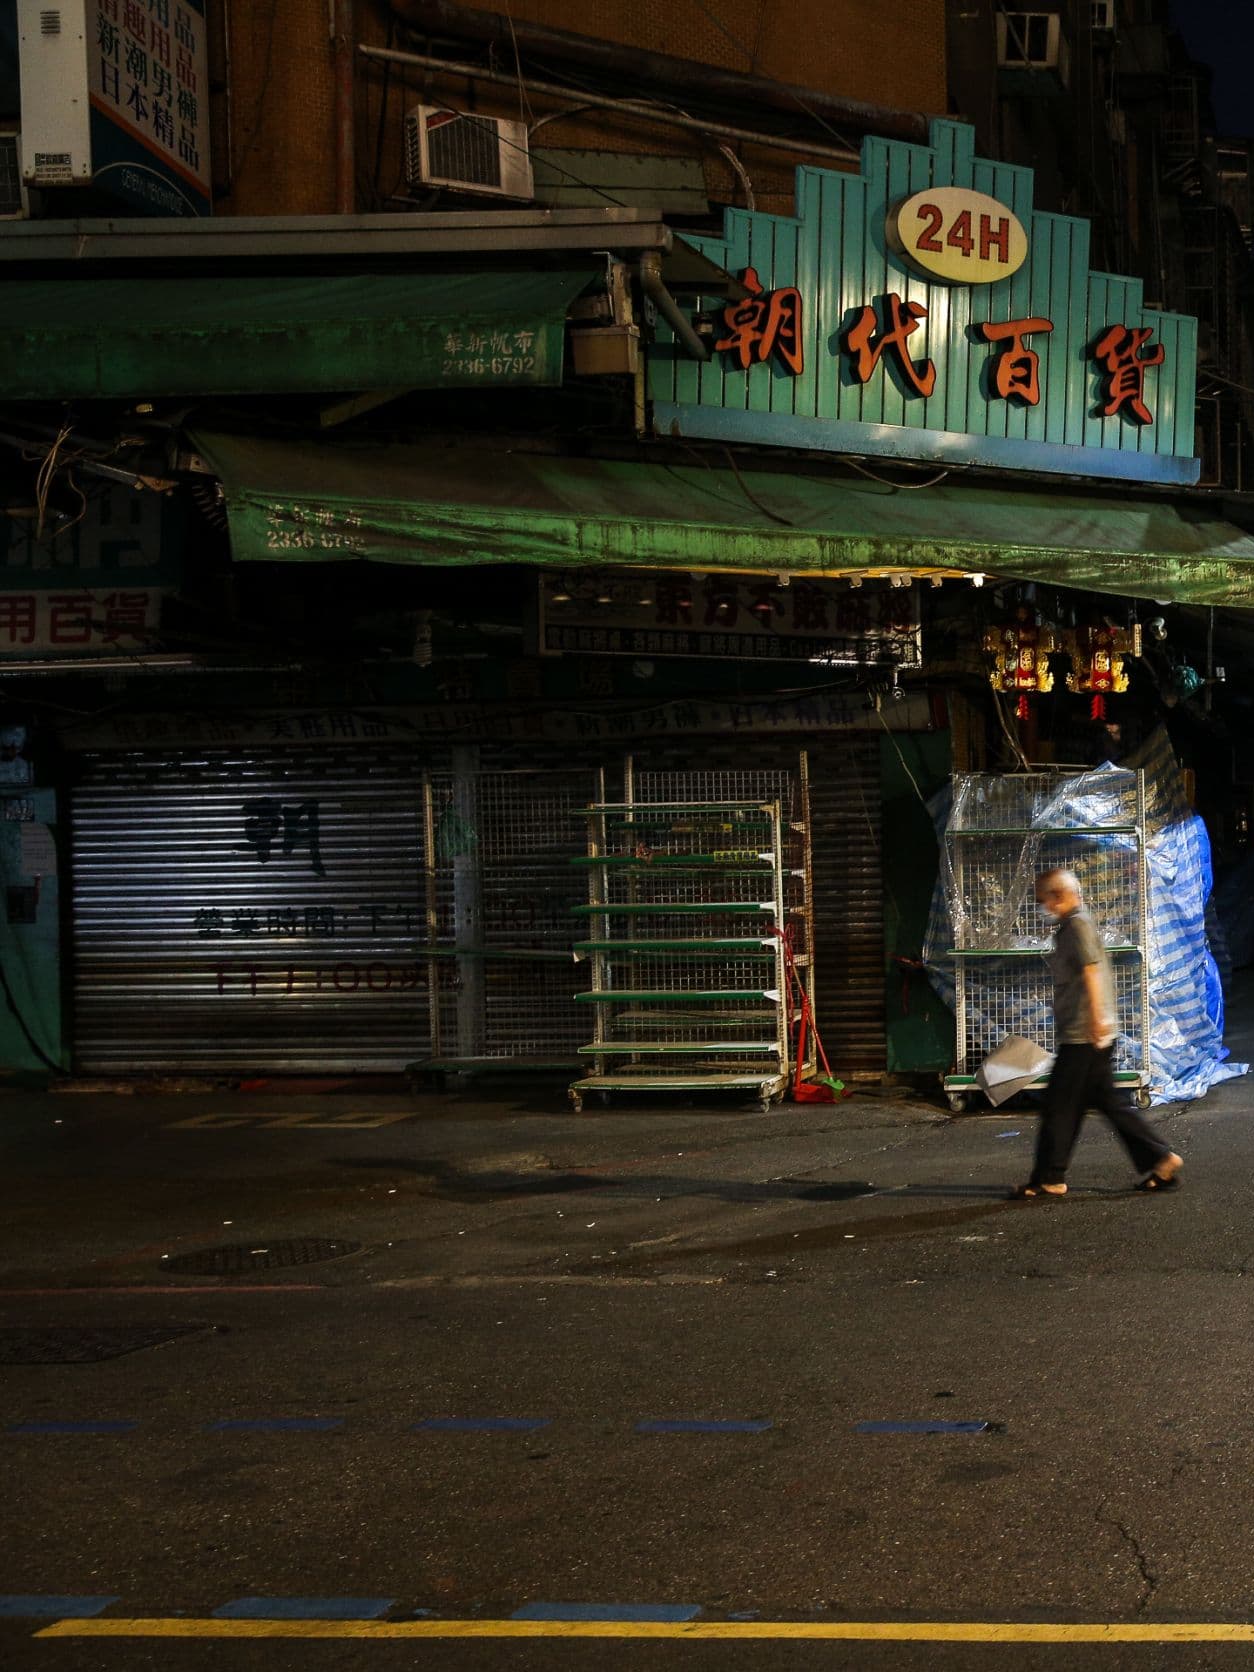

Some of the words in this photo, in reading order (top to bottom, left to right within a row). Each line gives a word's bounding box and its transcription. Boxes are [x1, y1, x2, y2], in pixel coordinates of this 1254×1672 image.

[97, 12, 198, 129] 新潮男褲
[100, 57, 199, 171] 日本精品
[916, 203, 1010, 264] 24H
[714, 266, 1166, 425] 朝代百貨
[233, 797, 326, 877] 朝
